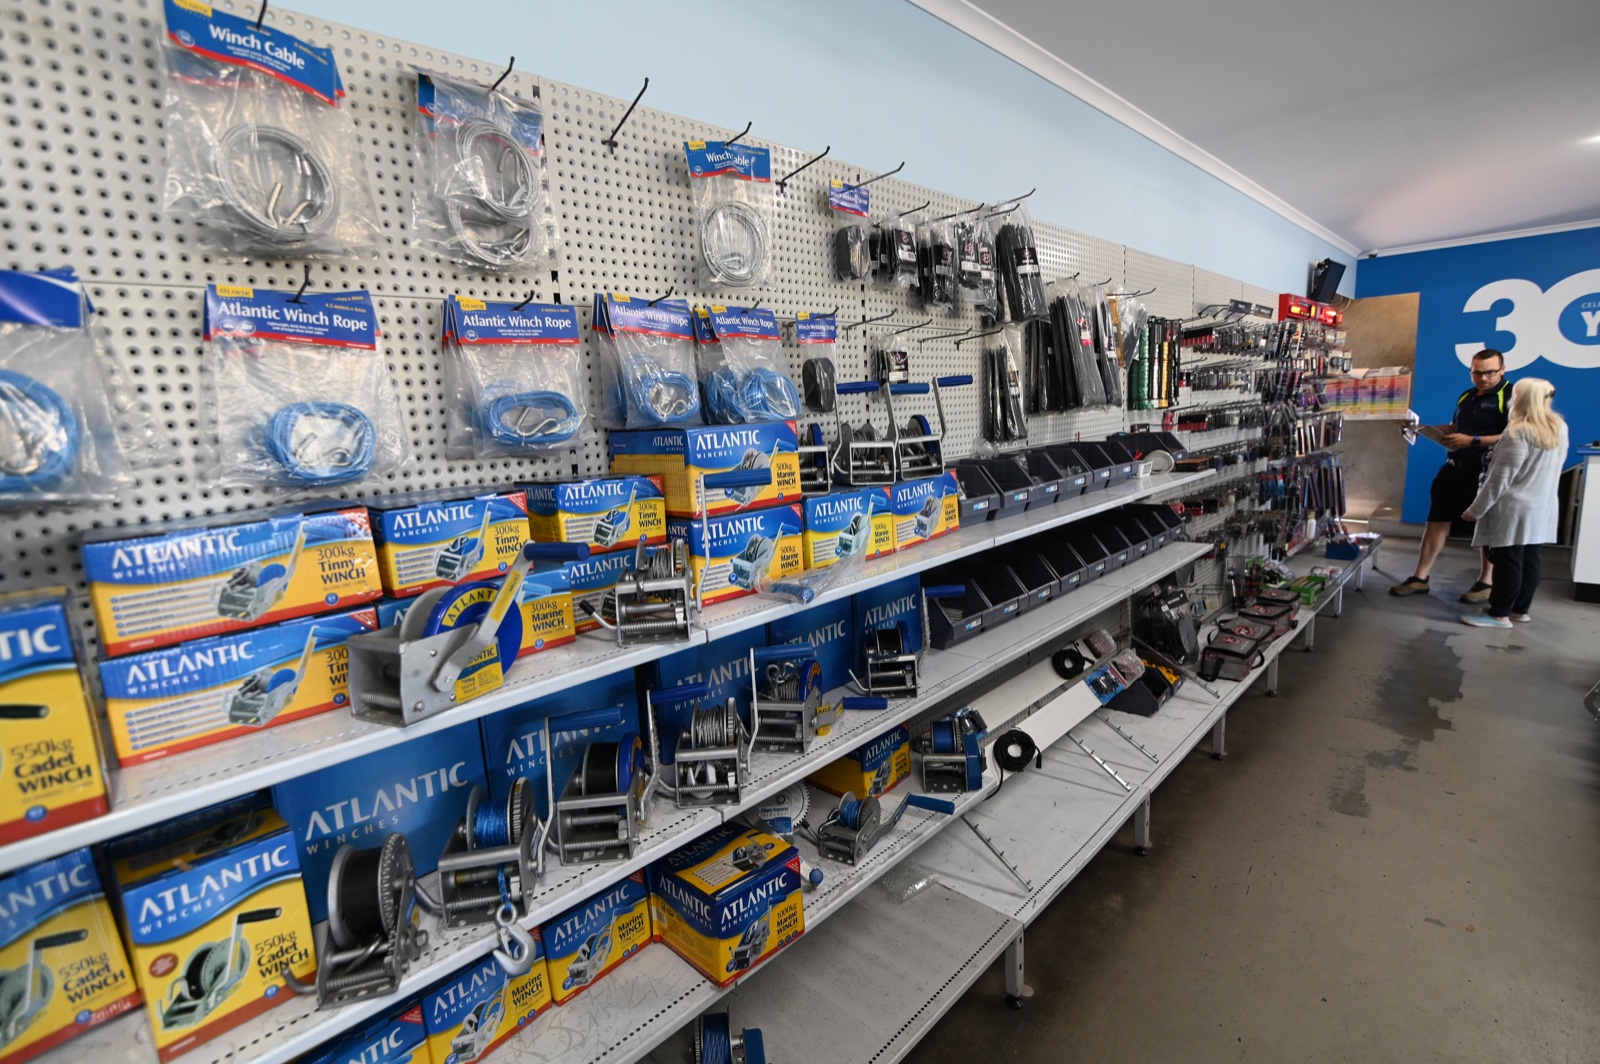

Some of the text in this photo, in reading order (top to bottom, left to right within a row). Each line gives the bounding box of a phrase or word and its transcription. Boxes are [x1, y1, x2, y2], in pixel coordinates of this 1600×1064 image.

[209, 23, 261, 51] Winch
[264, 40, 306, 70] Cable
[706, 150, 732, 163] Winch
[733, 154, 750, 167] able
[218, 287, 251, 298] ATLANTIC
[1580, 301, 1600, 309] CEL
[218, 301, 368, 332] Atlantic Winch Rope
[463, 314, 572, 330] Atlantic Winch Rope
[614, 305, 645, 319] Atlantic
[646, 311, 669, 323] Winch
[670, 316, 688, 328] Rope
[715, 316, 741, 326] Atlantic
[742, 317, 760, 327] Winch
[760, 319, 774, 329] Rope
[1580, 310, 1600, 337] Y
[652, 435, 684, 447] ATLANTIC
[696, 429, 761, 451] ATLANTIC
[697, 450, 733, 459] WINCHES
[776, 462, 792, 471] 500kg
[776, 470, 796, 479] Marine
[564, 482, 625, 500] ATLANTIC
[776, 478, 797, 487] WINCH
[896, 480, 936, 504] ATLANTIC
[565, 499, 598, 507] WINCHES
[638, 502, 658, 511] 300kg
[814, 496, 863, 518] ATLANTIC
[393, 503, 475, 531] ATLANTIC
[638, 511, 658, 521] Tinny
[638, 517, 662, 528] WINCH
[814, 516, 842, 525] WINCHES
[393, 526, 440, 539] WINCHES
[494, 524, 520, 536] 300kg
[667, 524, 688, 536] ANTIC
[701, 516, 765, 541] ATLANTIC
[874, 529, 889, 538] Marine
[494, 534, 520, 546] Tinny
[780, 545, 796, 553] 500kg
[874, 536, 890, 545] WINCH
[111, 532, 243, 571] ATLANTIC
[317, 544, 356, 563] 300kg
[780, 552, 799, 561] Marine
[112, 561, 188, 580] WINCHES
[318, 558, 356, 573] Tinny
[570, 554, 631, 579] ATLANTIC
[780, 559, 799, 570] WINCH
[320, 567, 366, 586] WINCH
[570, 574, 605, 585] WINCHES
[447, 589, 493, 623] ATLANT
[530, 599, 558, 614] 300kg
[531, 609, 564, 623] Marine
[864, 594, 917, 628] ATLANTIC
[532, 618, 565, 633] WINCH
[126, 641, 255, 686] ATLANTIC
[325, 647, 349, 664] 300
[326, 661, 349, 674] Tin
[127, 673, 200, 695] WINCHES
[10, 738, 75, 764] 550kg
[866, 728, 902, 762] ATLANTIC
[14, 752, 76, 779] Cadet
[506, 745, 574, 777] WINCES
[18, 764, 93, 794] WINCH
[305, 761, 468, 841] ATLANTIC
[306, 814, 399, 855] WINCHES
[668, 827, 734, 864] ATLANTIC
[139, 845, 290, 923] ATLANTIC
[660, 875, 712, 921] ATLANTIC
[721, 872, 788, 925] ATLANTIC
[139, 894, 226, 935] WINCHES
[554, 884, 630, 944] ATLANTIC
[618, 912, 644, 934] Marine
[682, 906, 713, 930] WINCHES
[721, 906, 759, 932] WINCHES
[776, 910, 798, 927] Marine
[555, 921, 598, 952] WINCHES
[618, 920, 645, 941] WINCH
[776, 917, 798, 936] WINCH
[255, 931, 297, 956] 550kg
[257, 941, 299, 967] Cadet
[59, 951, 110, 980] 550kg
[259, 948, 310, 979] WINCH
[63, 962, 113, 992] Cadet
[66, 968, 126, 1004] WINCH
[434, 958, 504, 1018] ATLAN
[511, 973, 542, 998] Marine
[512, 980, 543, 1007] WINCH
[434, 987, 486, 1025] WINCHES
